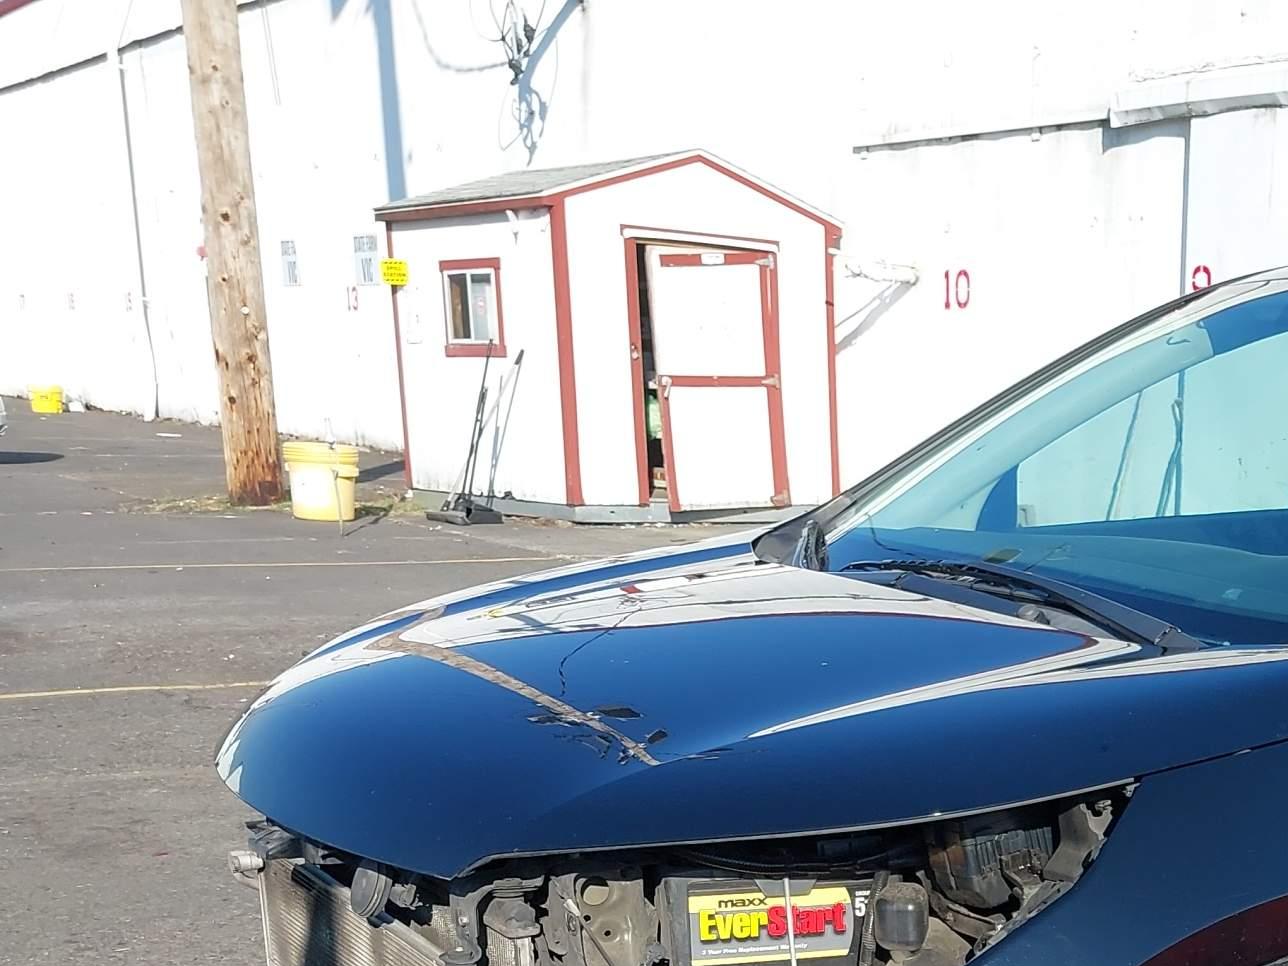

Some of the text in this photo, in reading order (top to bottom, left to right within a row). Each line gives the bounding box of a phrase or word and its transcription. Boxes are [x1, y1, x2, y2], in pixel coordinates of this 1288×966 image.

[346, 286, 359, 312] 13
[944, 269, 970, 310] 10
[718, 897, 768, 909] maxx
[699, 901, 848, 943] EverStart
